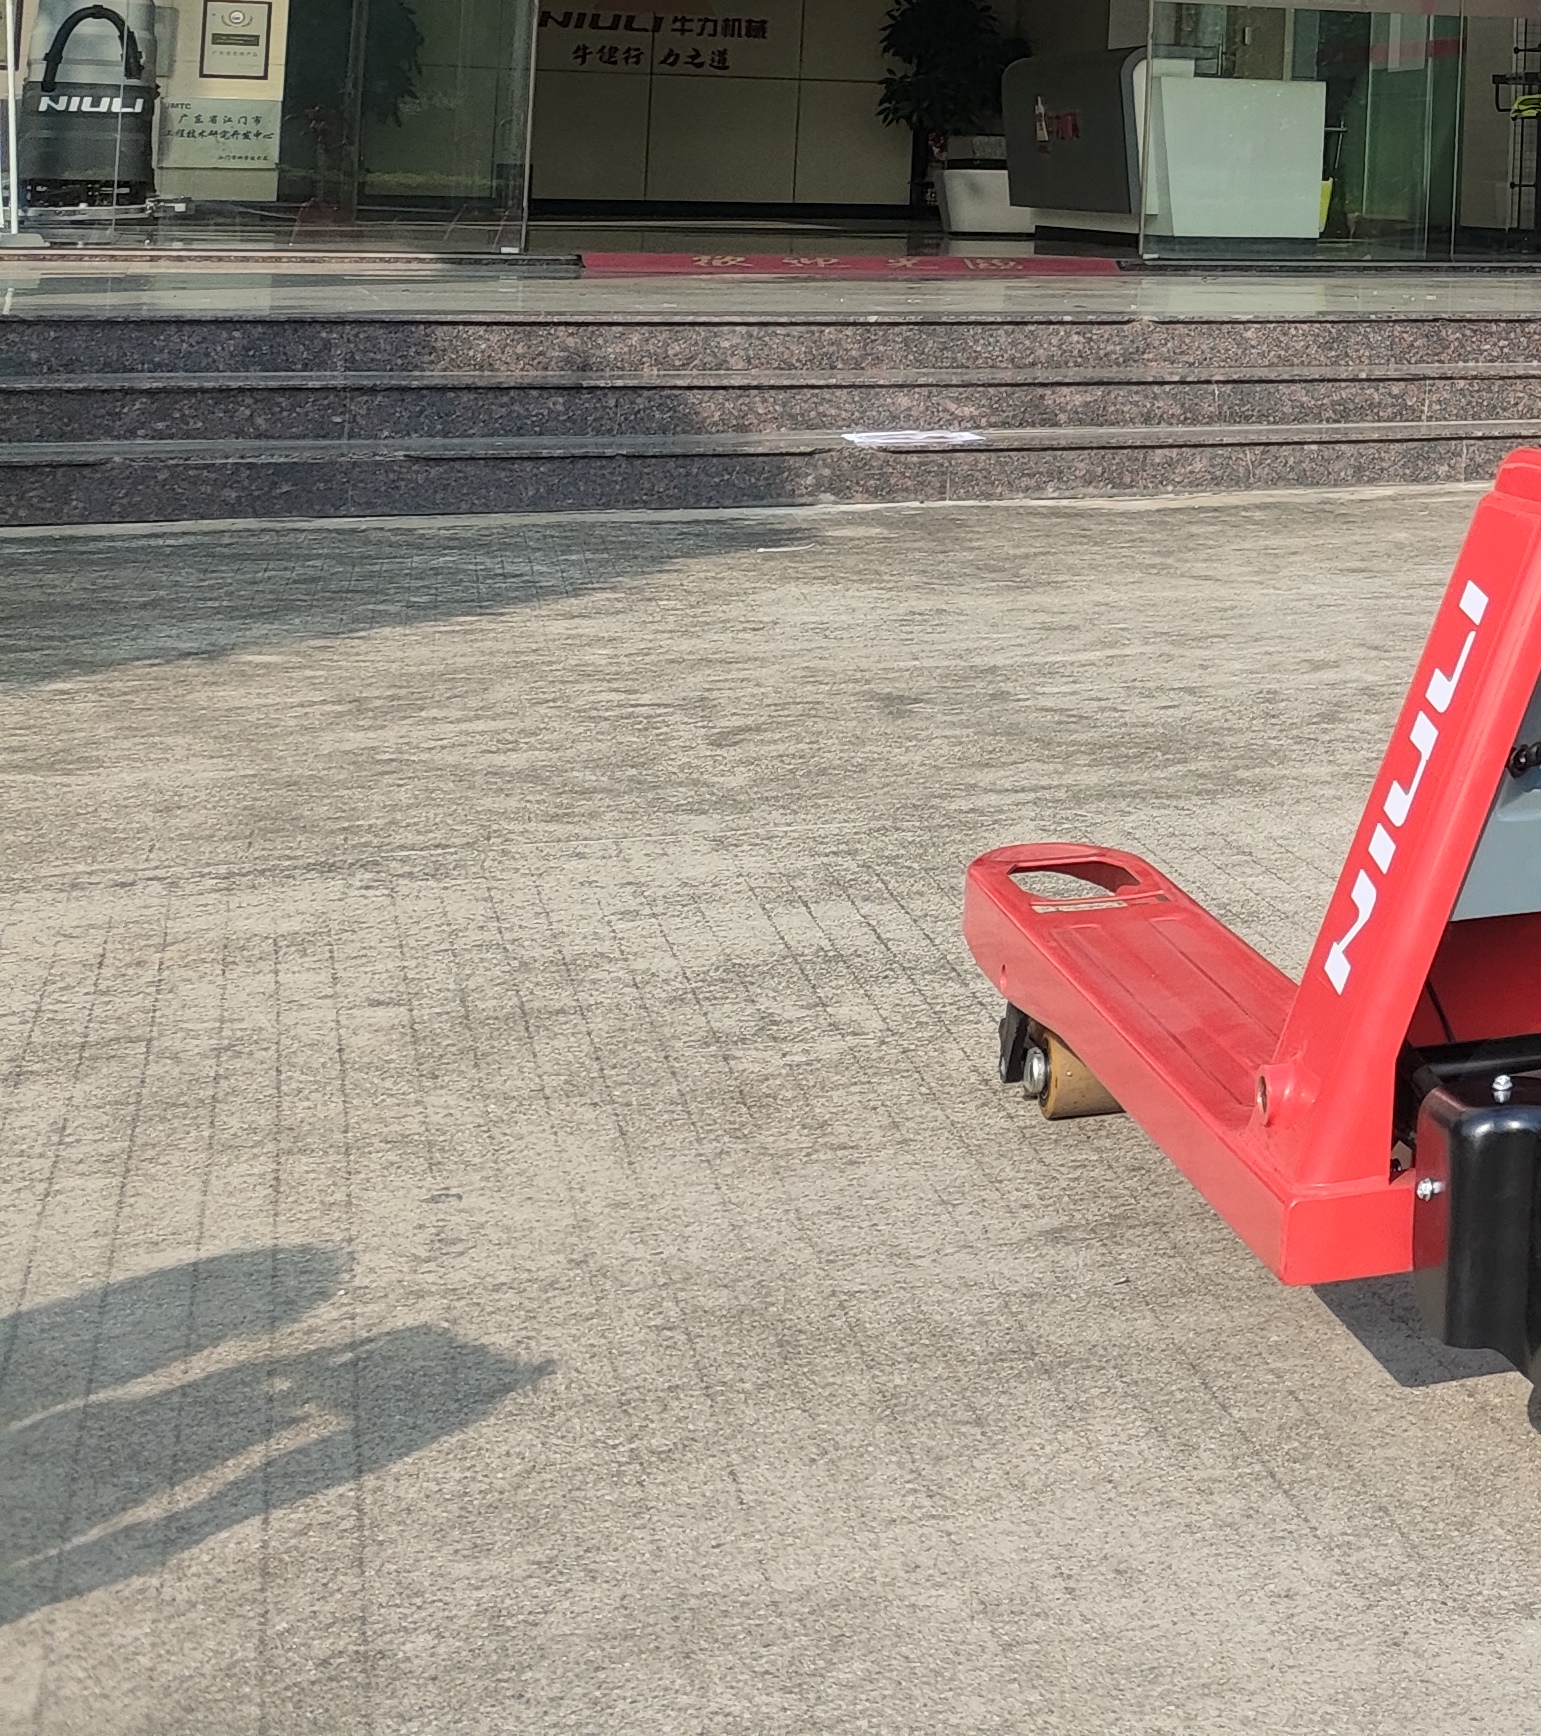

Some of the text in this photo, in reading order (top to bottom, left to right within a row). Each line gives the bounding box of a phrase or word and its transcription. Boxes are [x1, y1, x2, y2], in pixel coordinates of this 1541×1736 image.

[539, 11, 664, 34] NIULI
[38, 96, 145, 113] NIULI
[1323, 579, 1490, 996] NIULI
